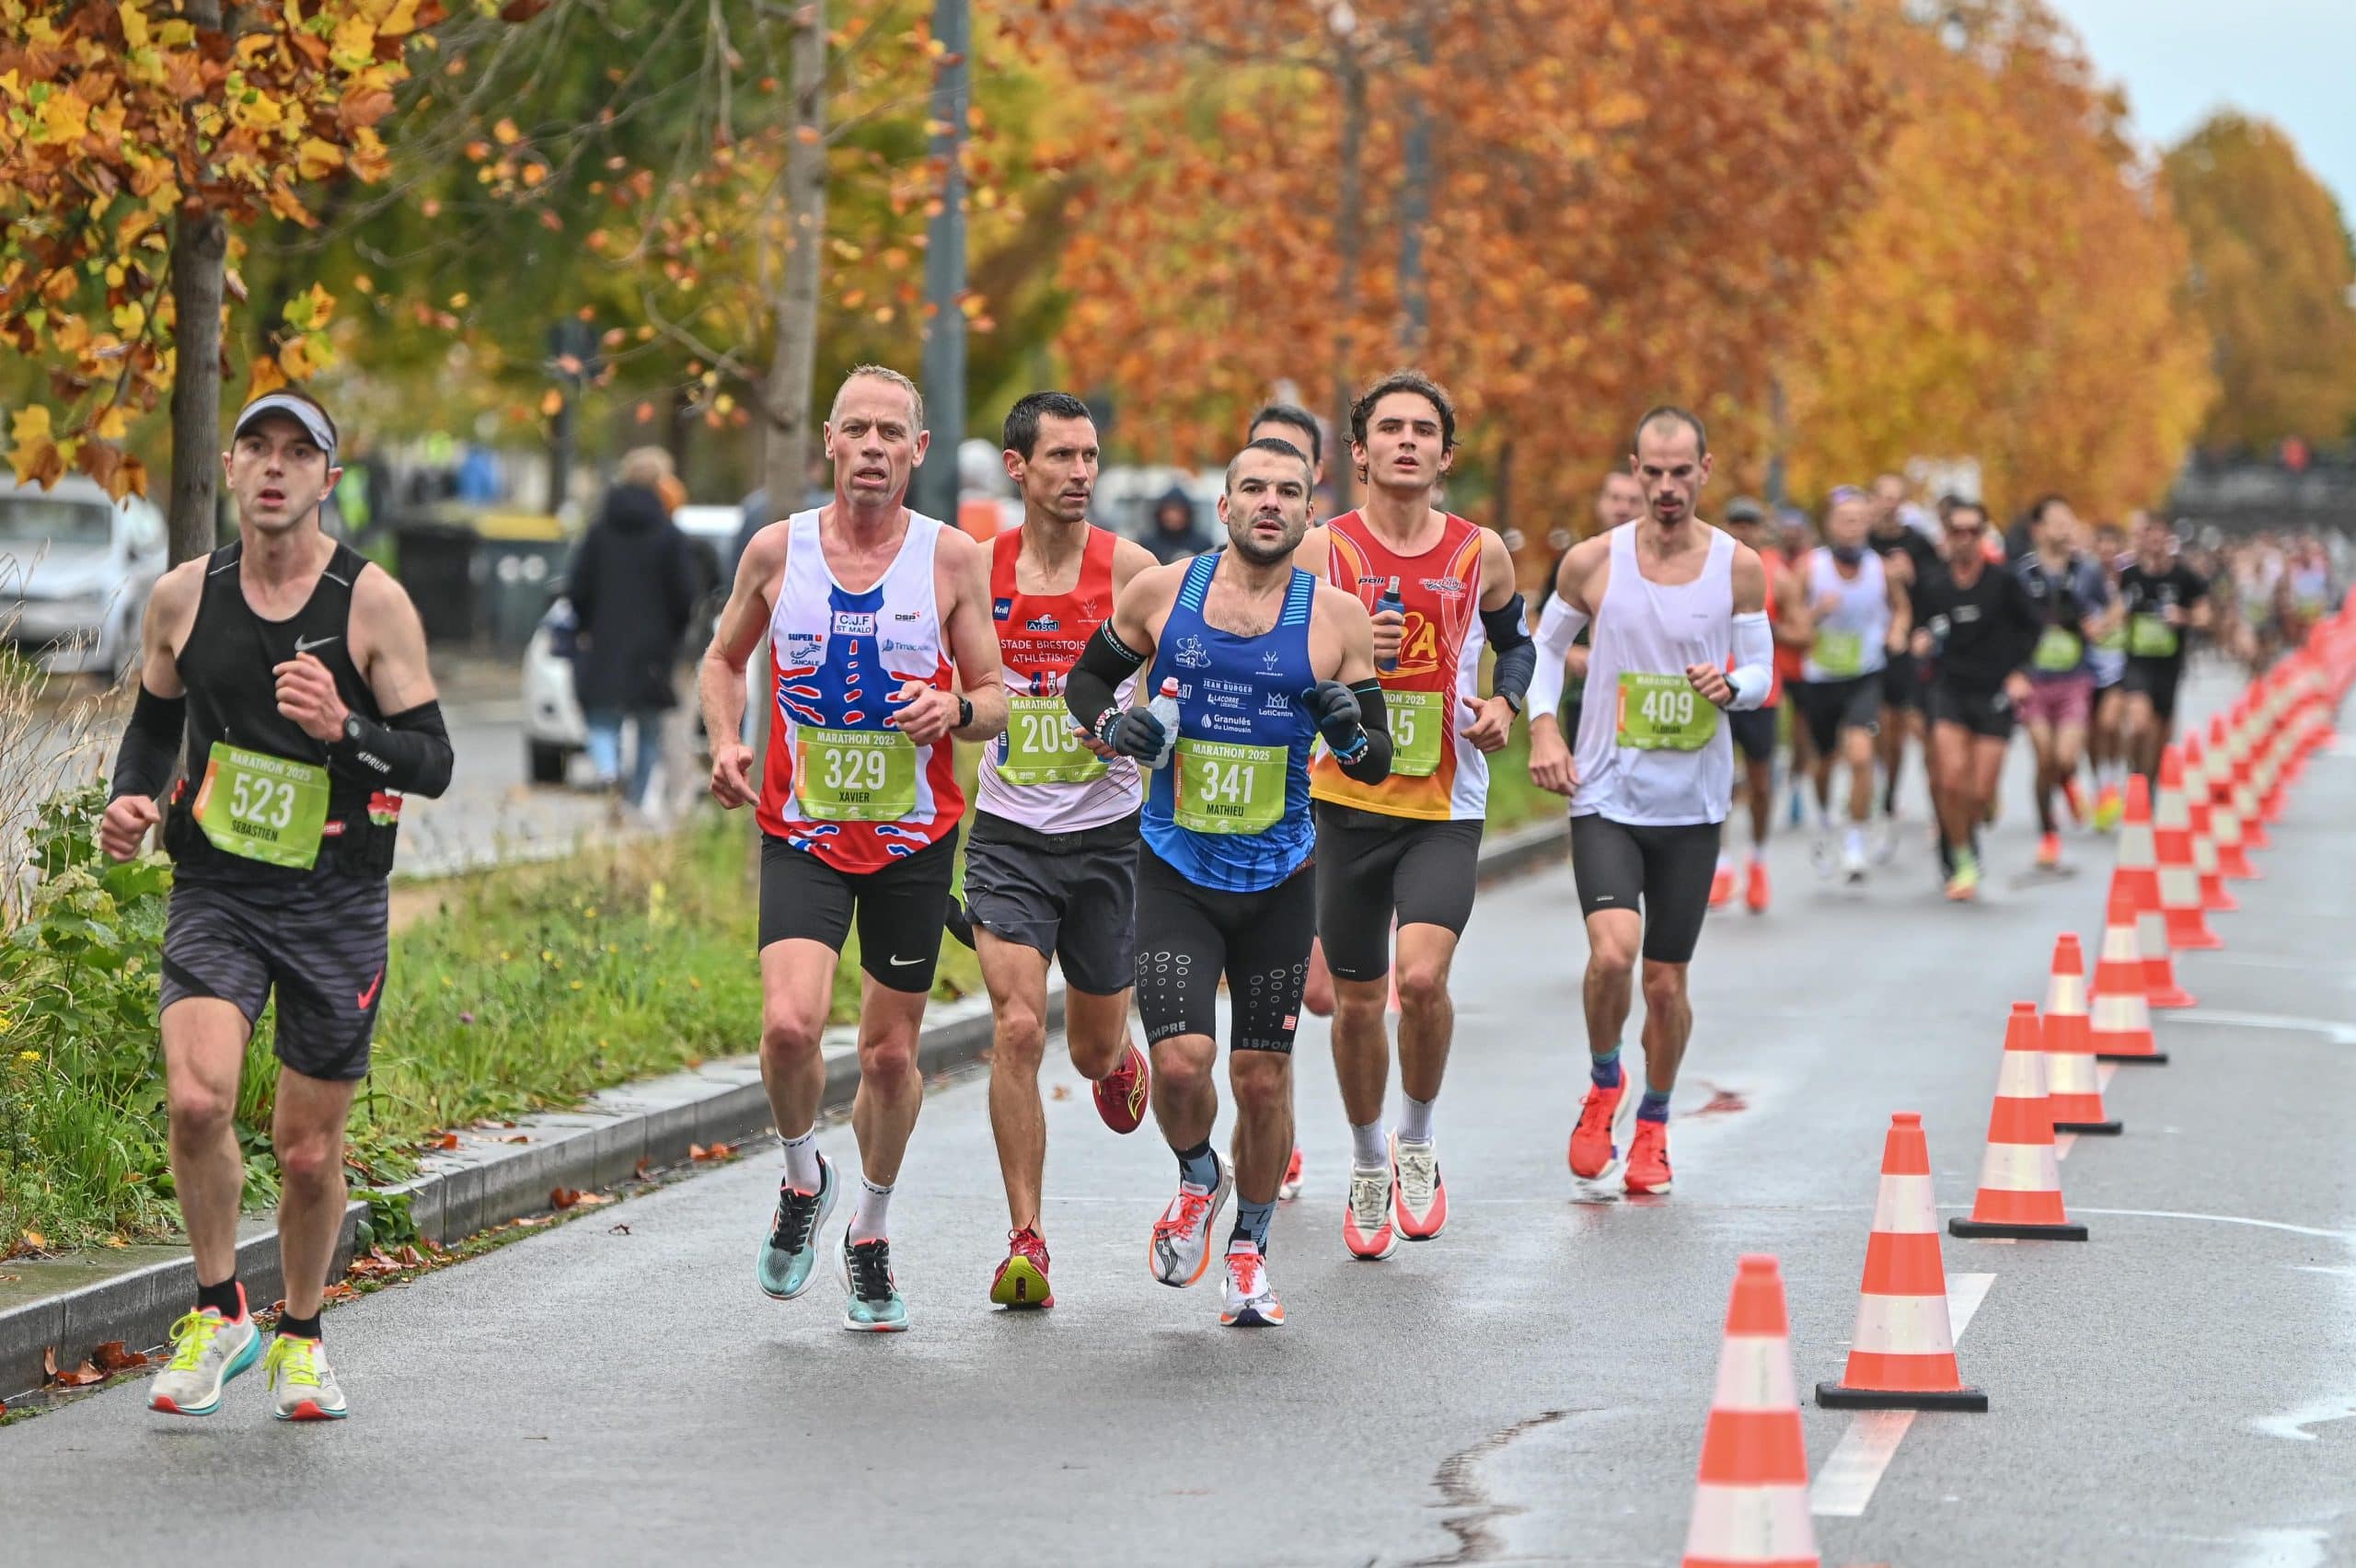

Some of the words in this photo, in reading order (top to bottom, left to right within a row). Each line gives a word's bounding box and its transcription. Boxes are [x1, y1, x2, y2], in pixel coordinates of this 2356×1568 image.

[839, 615, 869, 626] C.J.F
[1029, 621, 1057, 632] Argel
[849, 626, 871, 634] MALO
[1000, 640, 1032, 650] STADE
[1037, 640, 1086, 650] BRESTOIS
[1203, 680, 1221, 688] JEAN
[1223, 683, 1253, 693] BURGER
[1012, 700, 1058, 709] MARATHON
[1406, 695, 1426, 705] 2025
[1258, 708, 1294, 719] LotiCentre
[1641, 690, 1693, 725] 409
[1214, 714, 1252, 726] Granulés
[1022, 714, 1079, 753] 205
[1223, 724, 1252, 733] Limousin
[816, 732, 870, 744] MARATHON
[873, 735, 895, 745] 2025
[1193, 744, 1245, 759] MARATHON
[1248, 750, 1270, 761] 2025
[229, 751, 284, 774] MARATHON
[285, 765, 312, 781] 2025
[824, 748, 885, 790] 329
[1200, 761, 1254, 803] 341
[230, 772, 295, 828] 523
[838, 791, 870, 802] XAVIER
[1207, 803, 1244, 817] MATHIEU
[231, 819, 279, 842] SEBASTIEN
